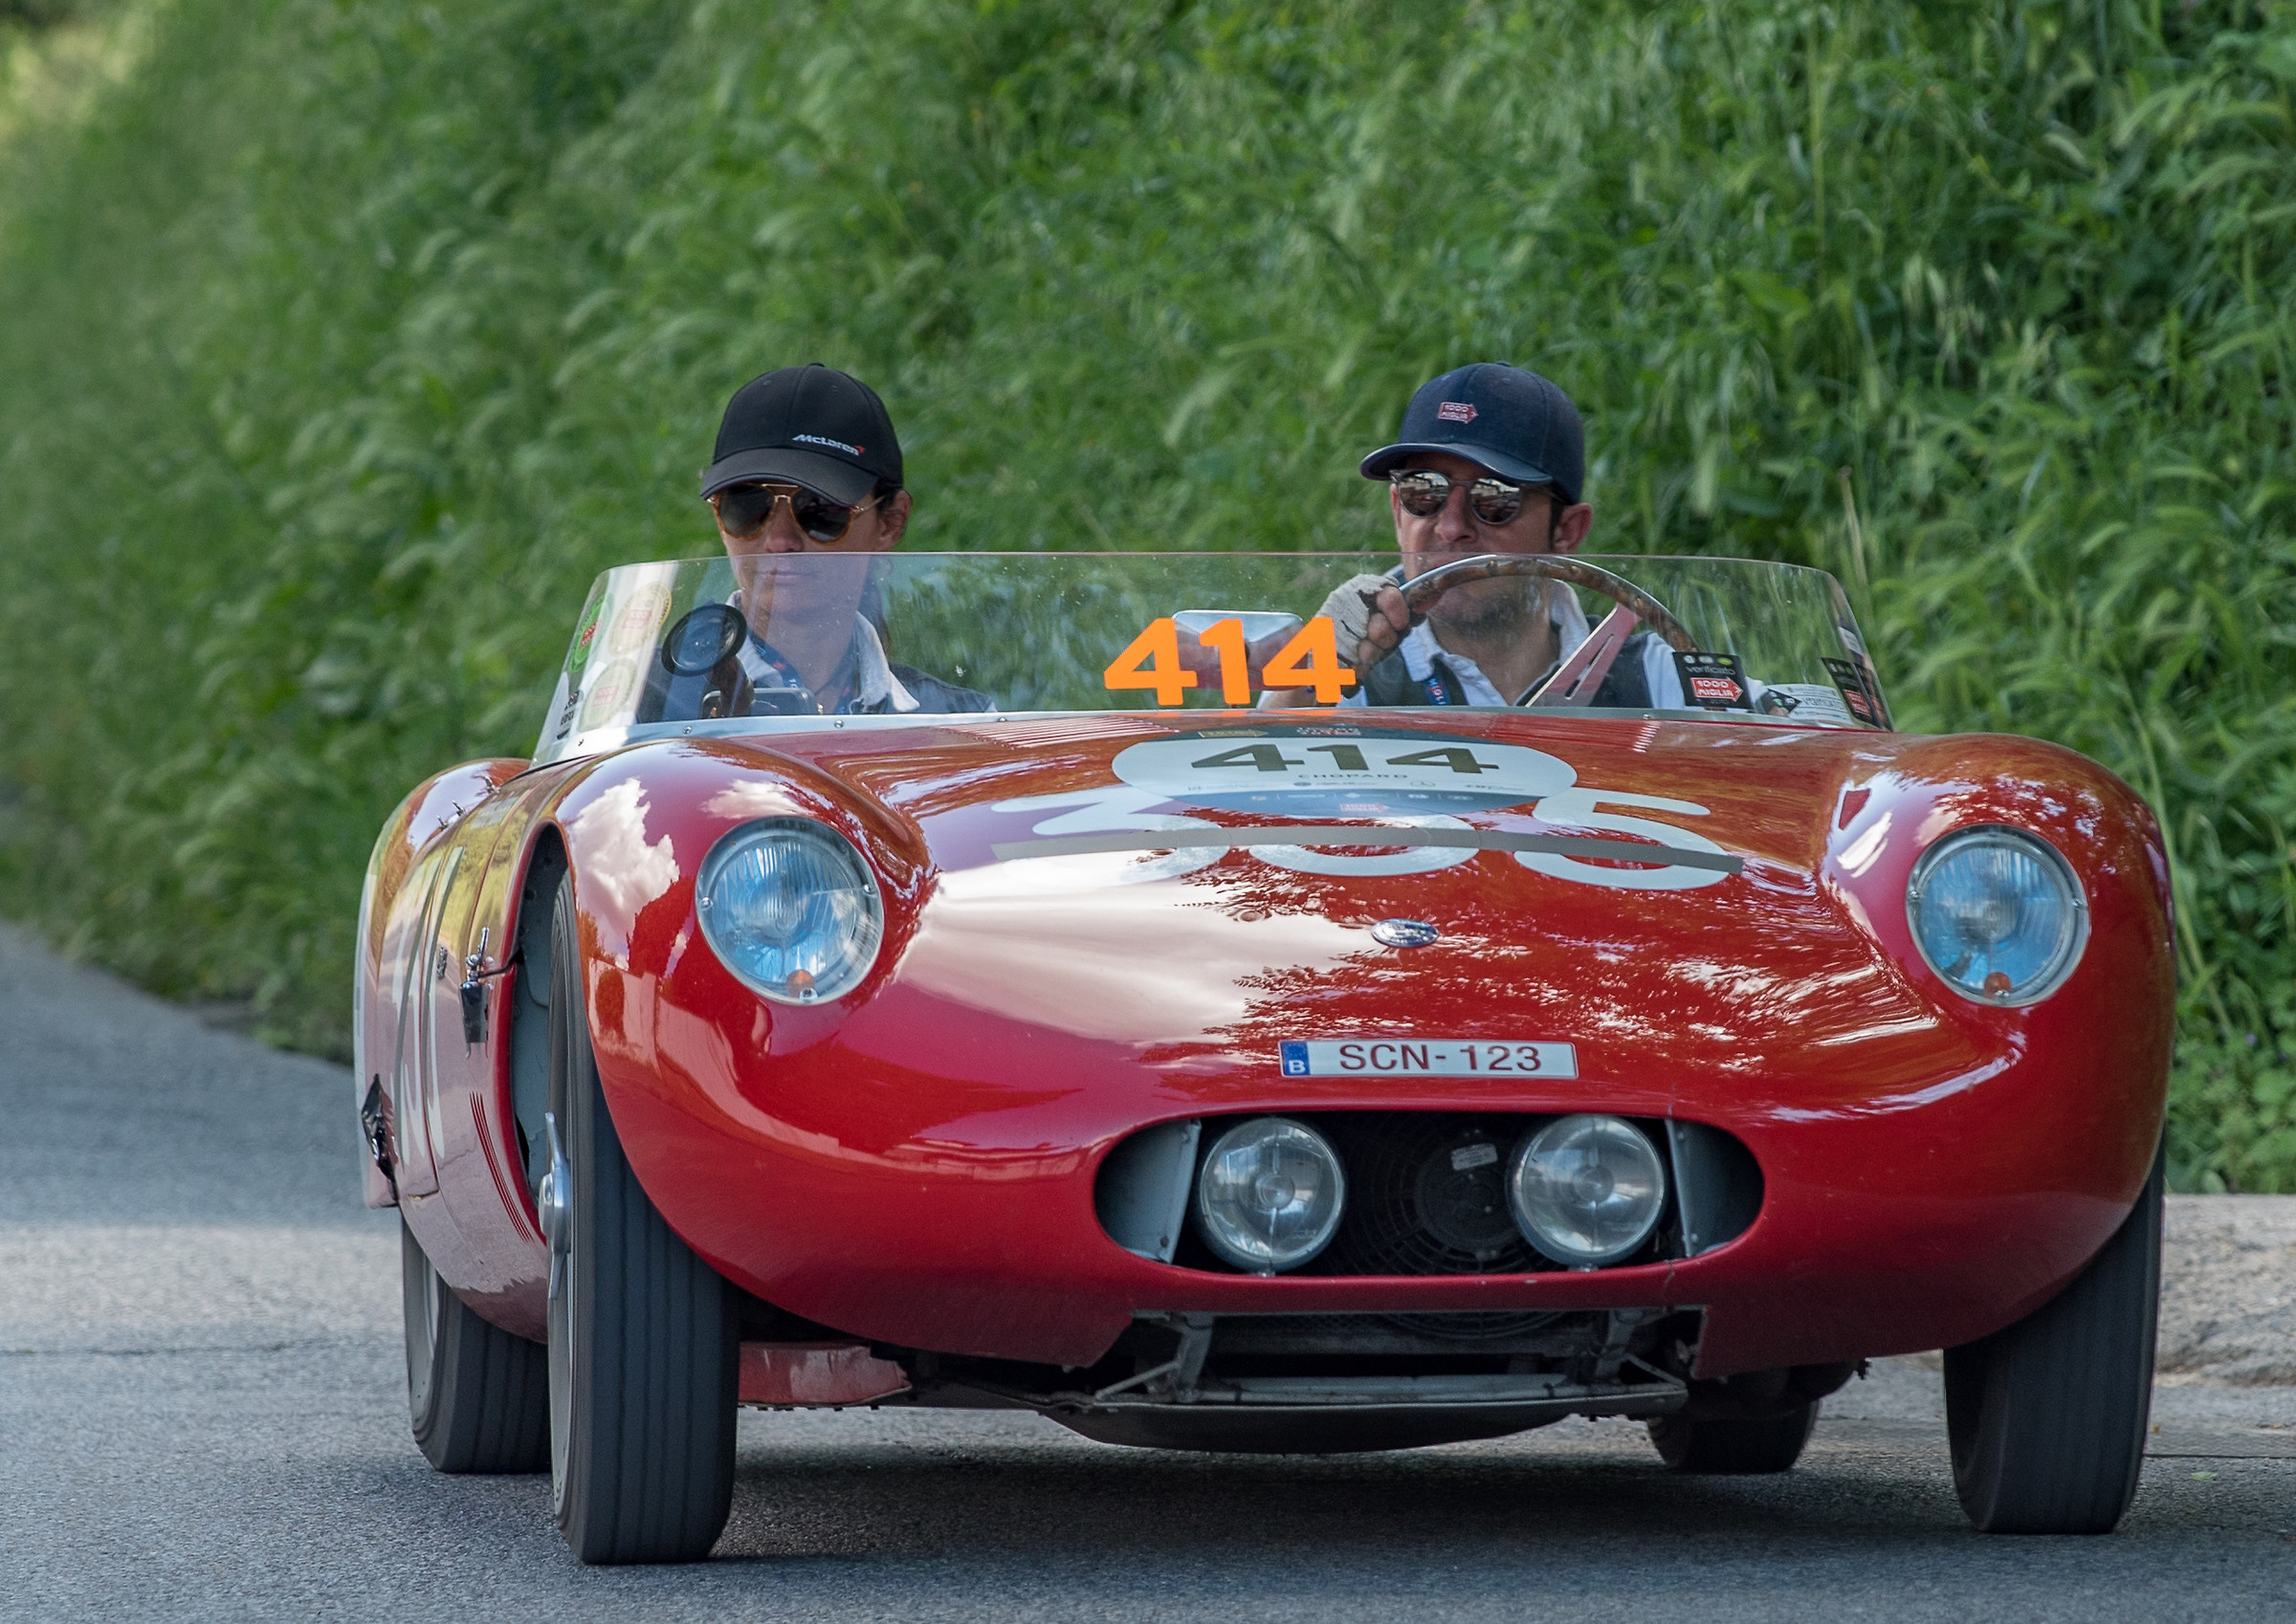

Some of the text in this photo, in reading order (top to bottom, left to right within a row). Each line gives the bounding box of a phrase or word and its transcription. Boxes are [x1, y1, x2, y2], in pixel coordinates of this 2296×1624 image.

[792, 434, 859, 456] McLaren
[1103, 616, 1357, 706] 414
[1696, 680, 1730, 689] 1000
[1697, 689, 1734, 697] MIGLIA
[1191, 743, 1500, 774] 414
[1289, 1059, 1307, 1074] B
